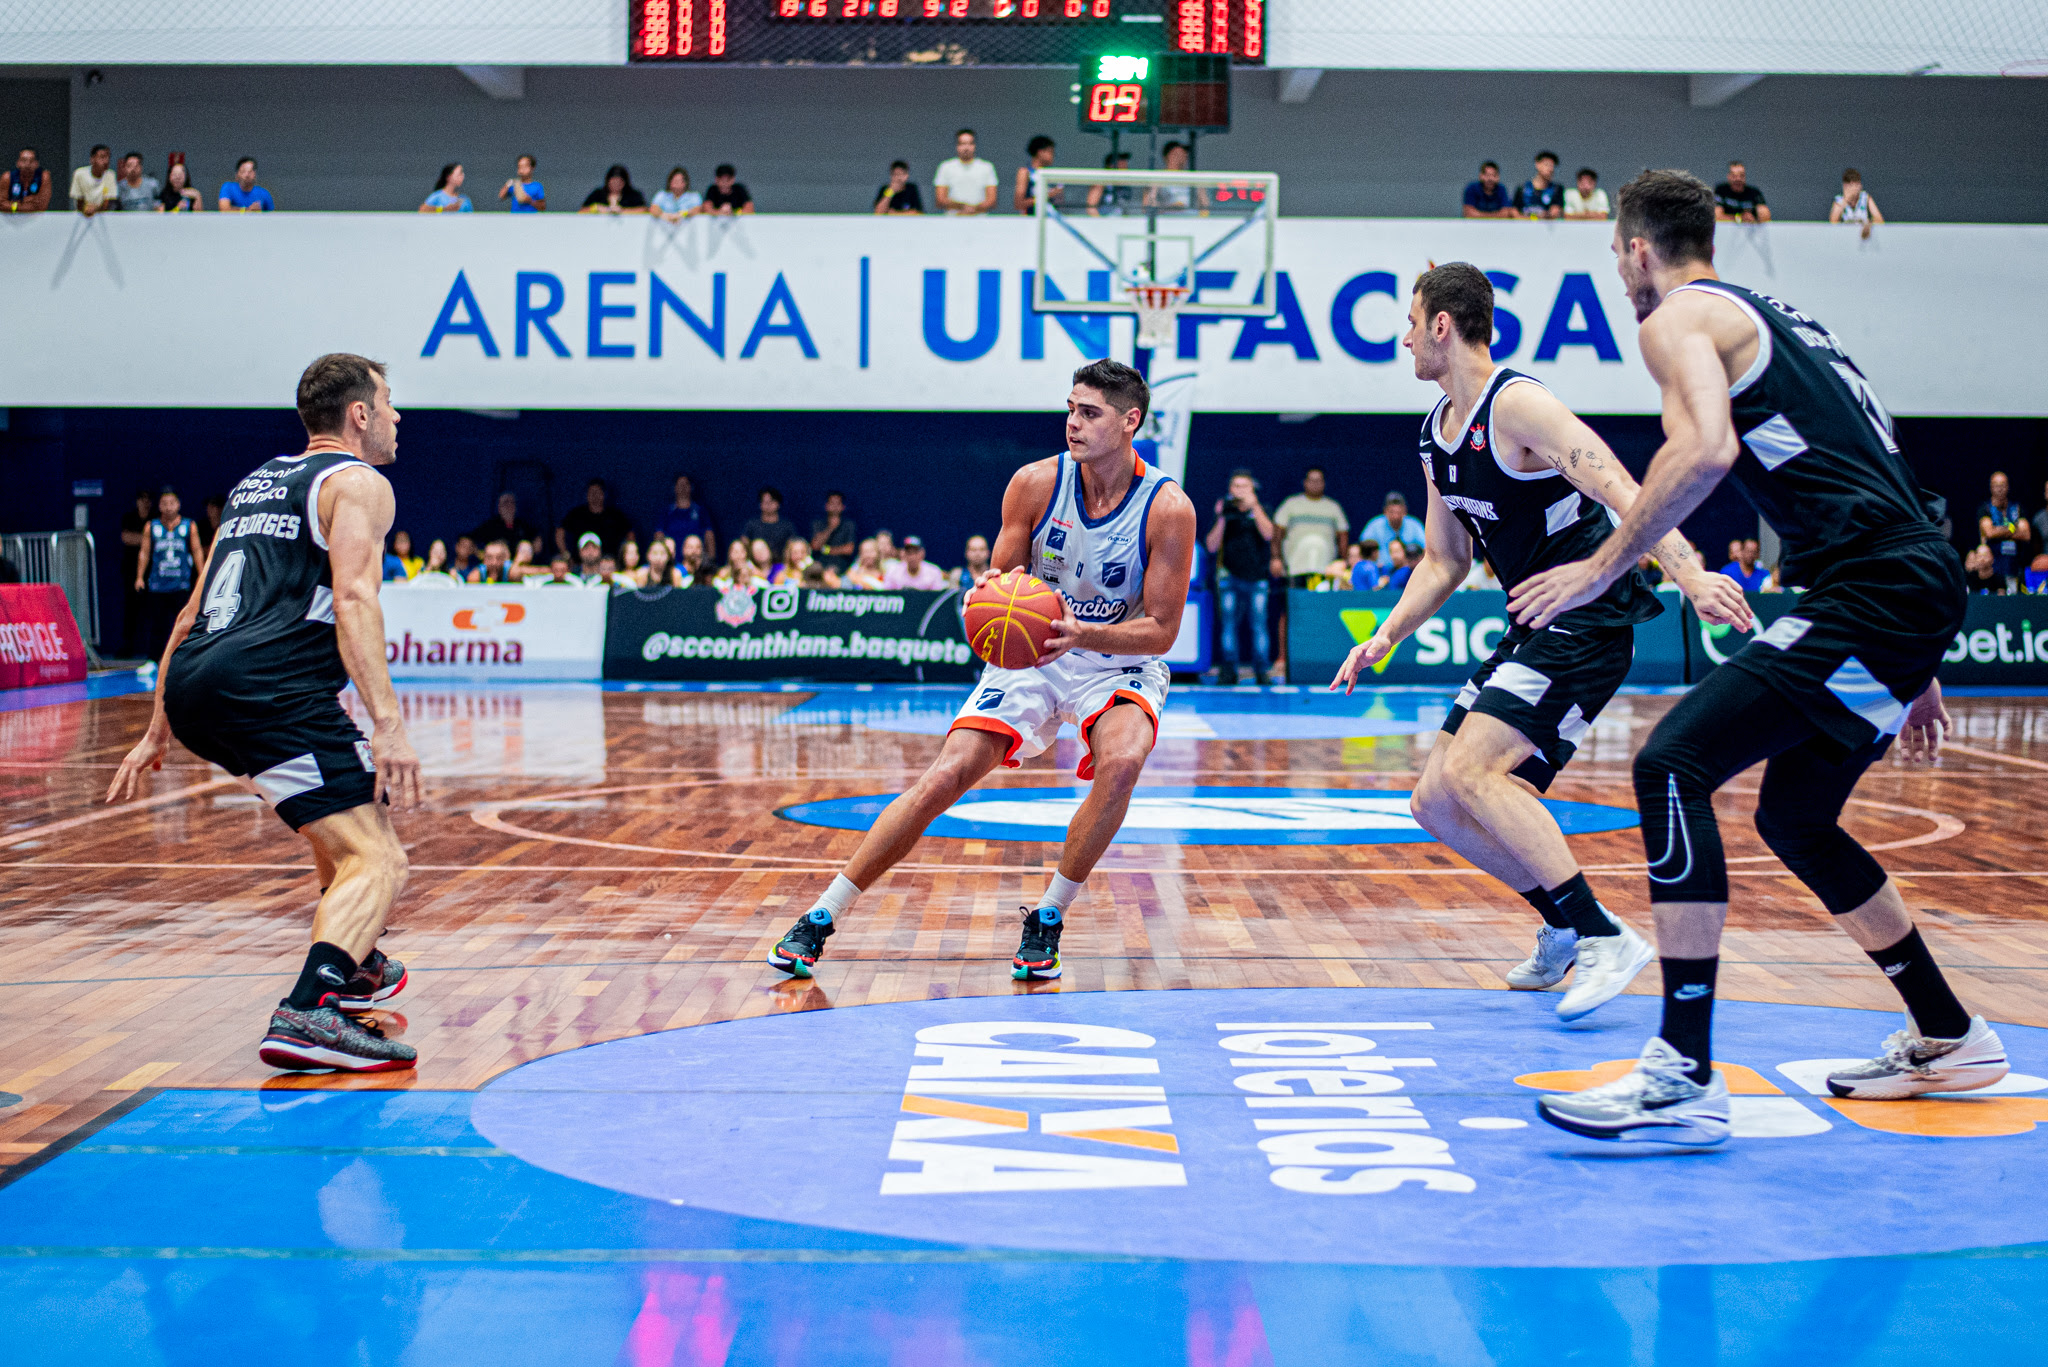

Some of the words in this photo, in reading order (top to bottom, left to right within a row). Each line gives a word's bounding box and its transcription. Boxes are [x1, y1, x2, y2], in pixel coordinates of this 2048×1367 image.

[420, 268, 820, 361] ARENA
[922, 267, 1623, 363] UNFACSA
[234, 512, 301, 540] BORGES
[237, 478, 273, 491] neo
[203, 549, 247, 634] 4
[642, 628, 972, 666] @sccorinthians.basquete
[879, 1021, 1188, 1196] CAIXA
[1215, 1021, 1529, 1194] loterias
